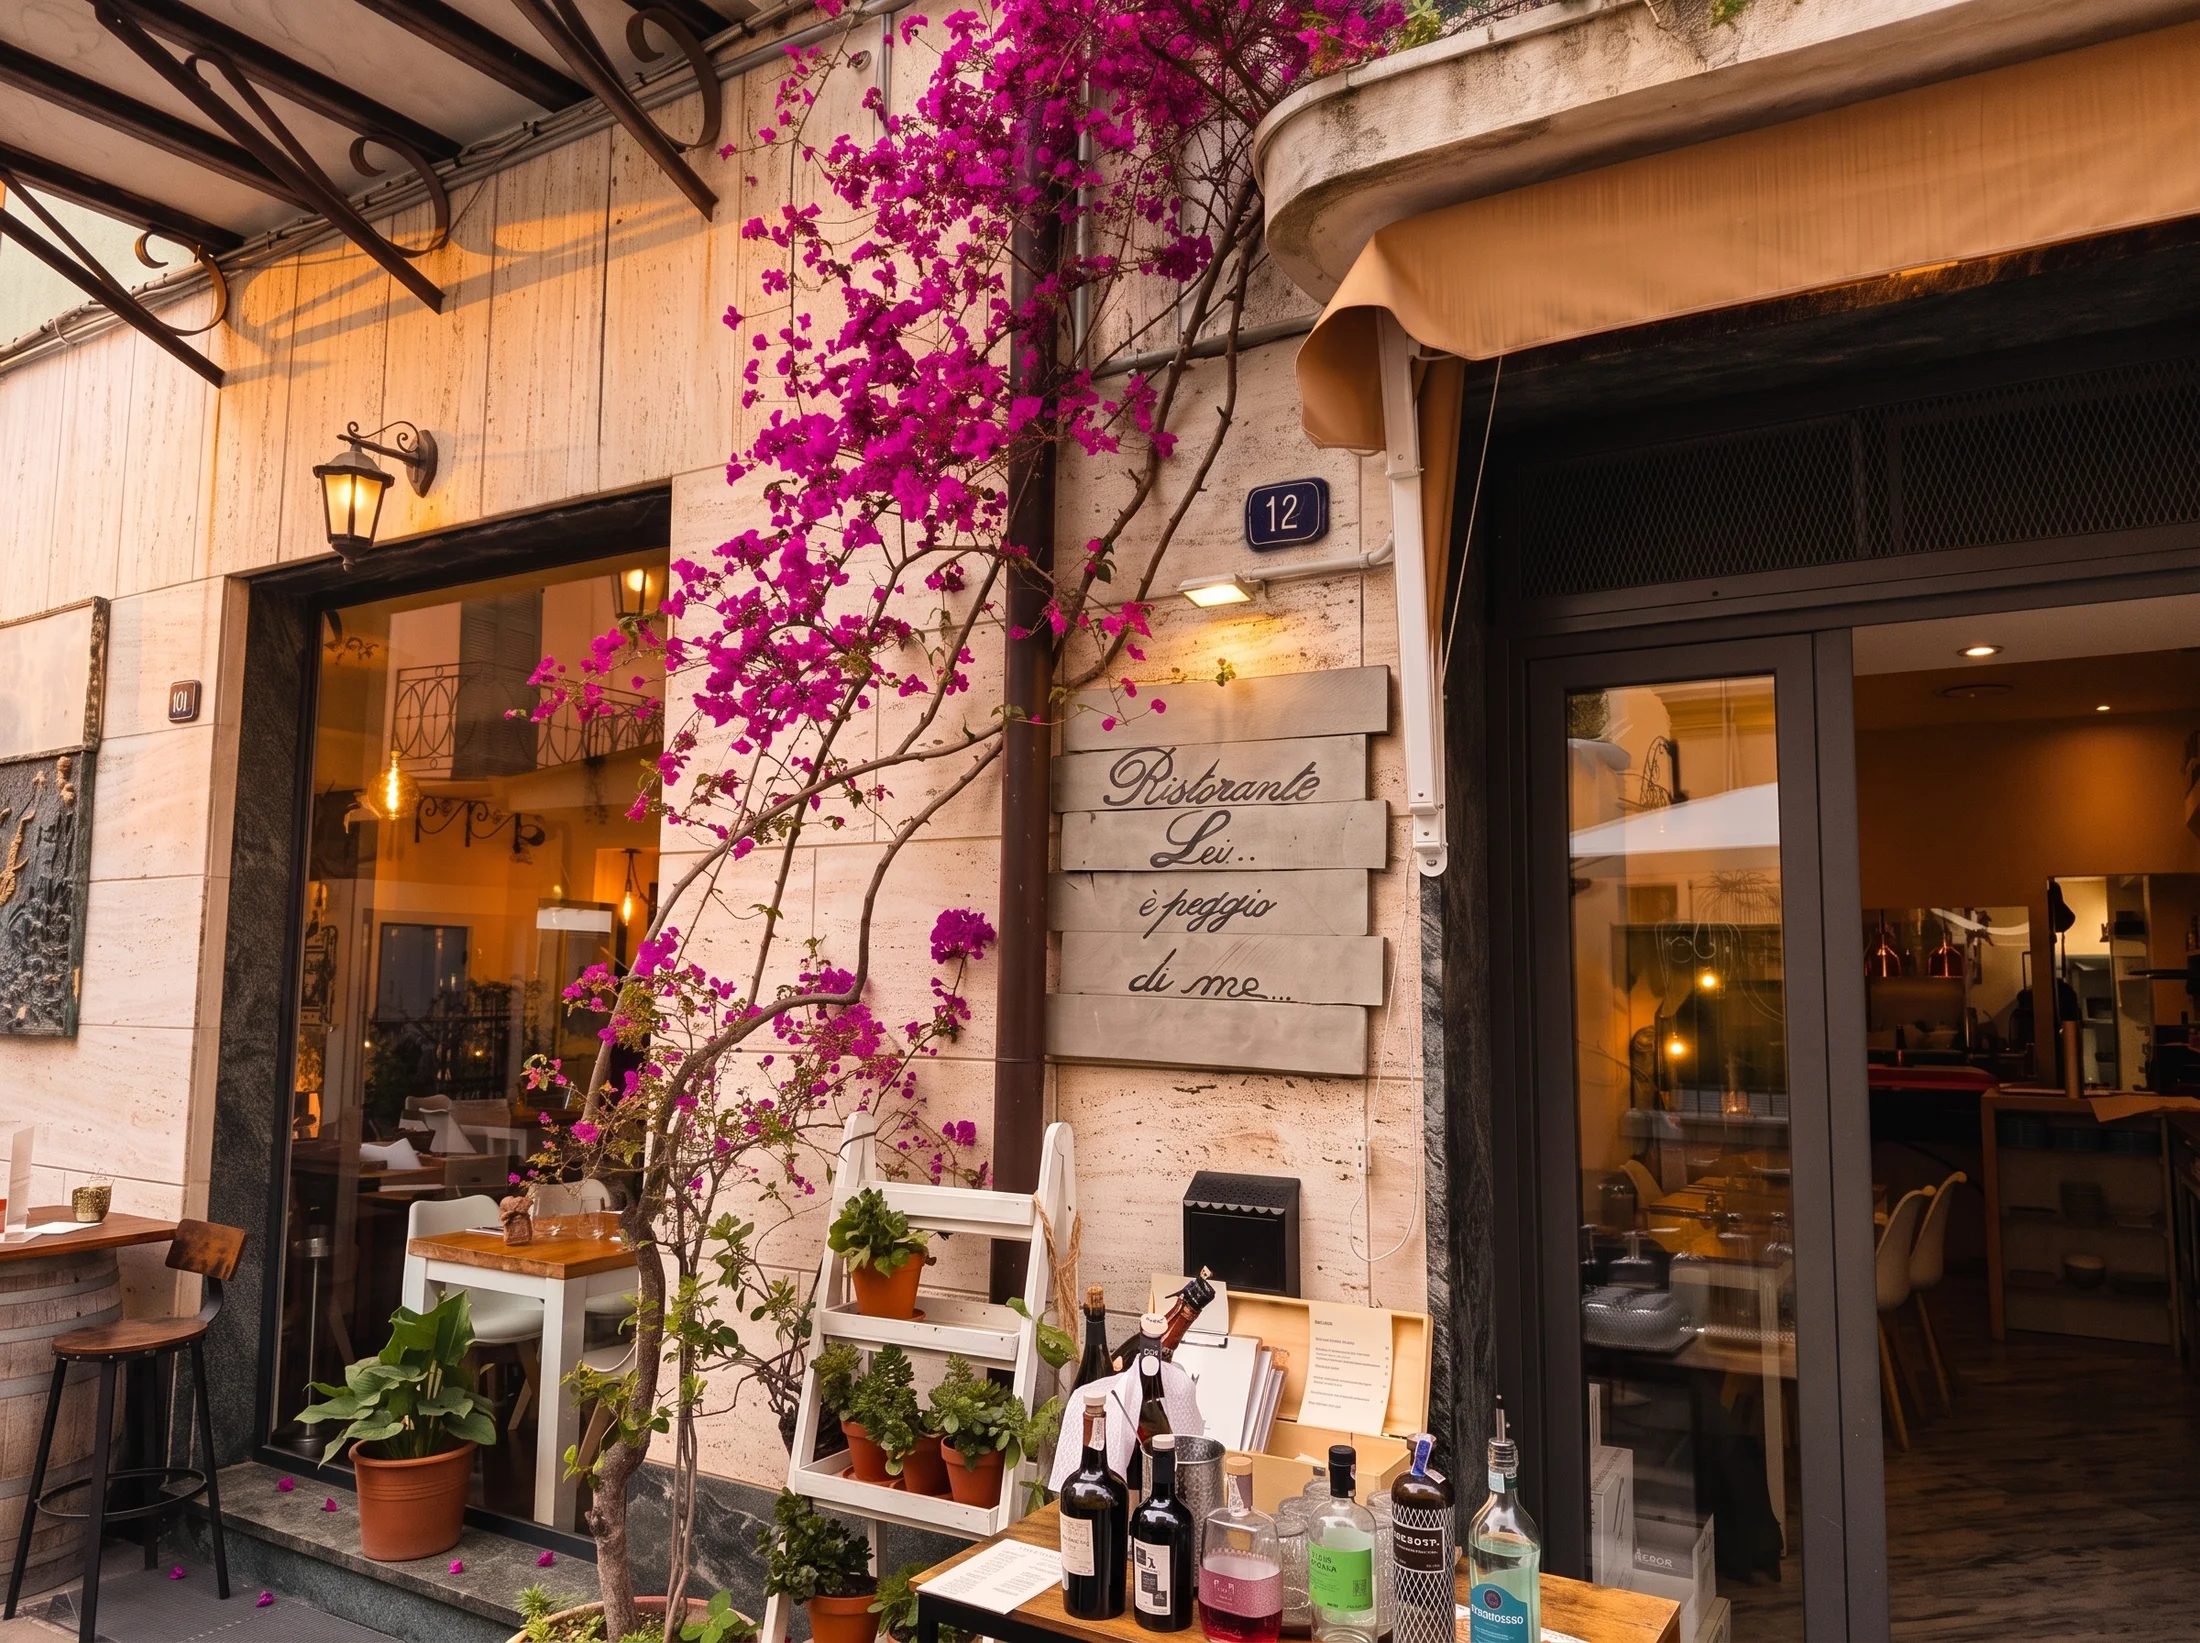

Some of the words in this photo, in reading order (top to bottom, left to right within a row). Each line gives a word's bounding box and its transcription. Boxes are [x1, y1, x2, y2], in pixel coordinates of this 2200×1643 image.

[1265, 493, 1298, 533] 12
[172, 690, 188, 713] 101
[1102, 745, 1321, 807] Ristorante
[1138, 888, 1159, 917] è
[1142, 888, 1278, 940] peggio
[1128, 948, 1175, 993] di
